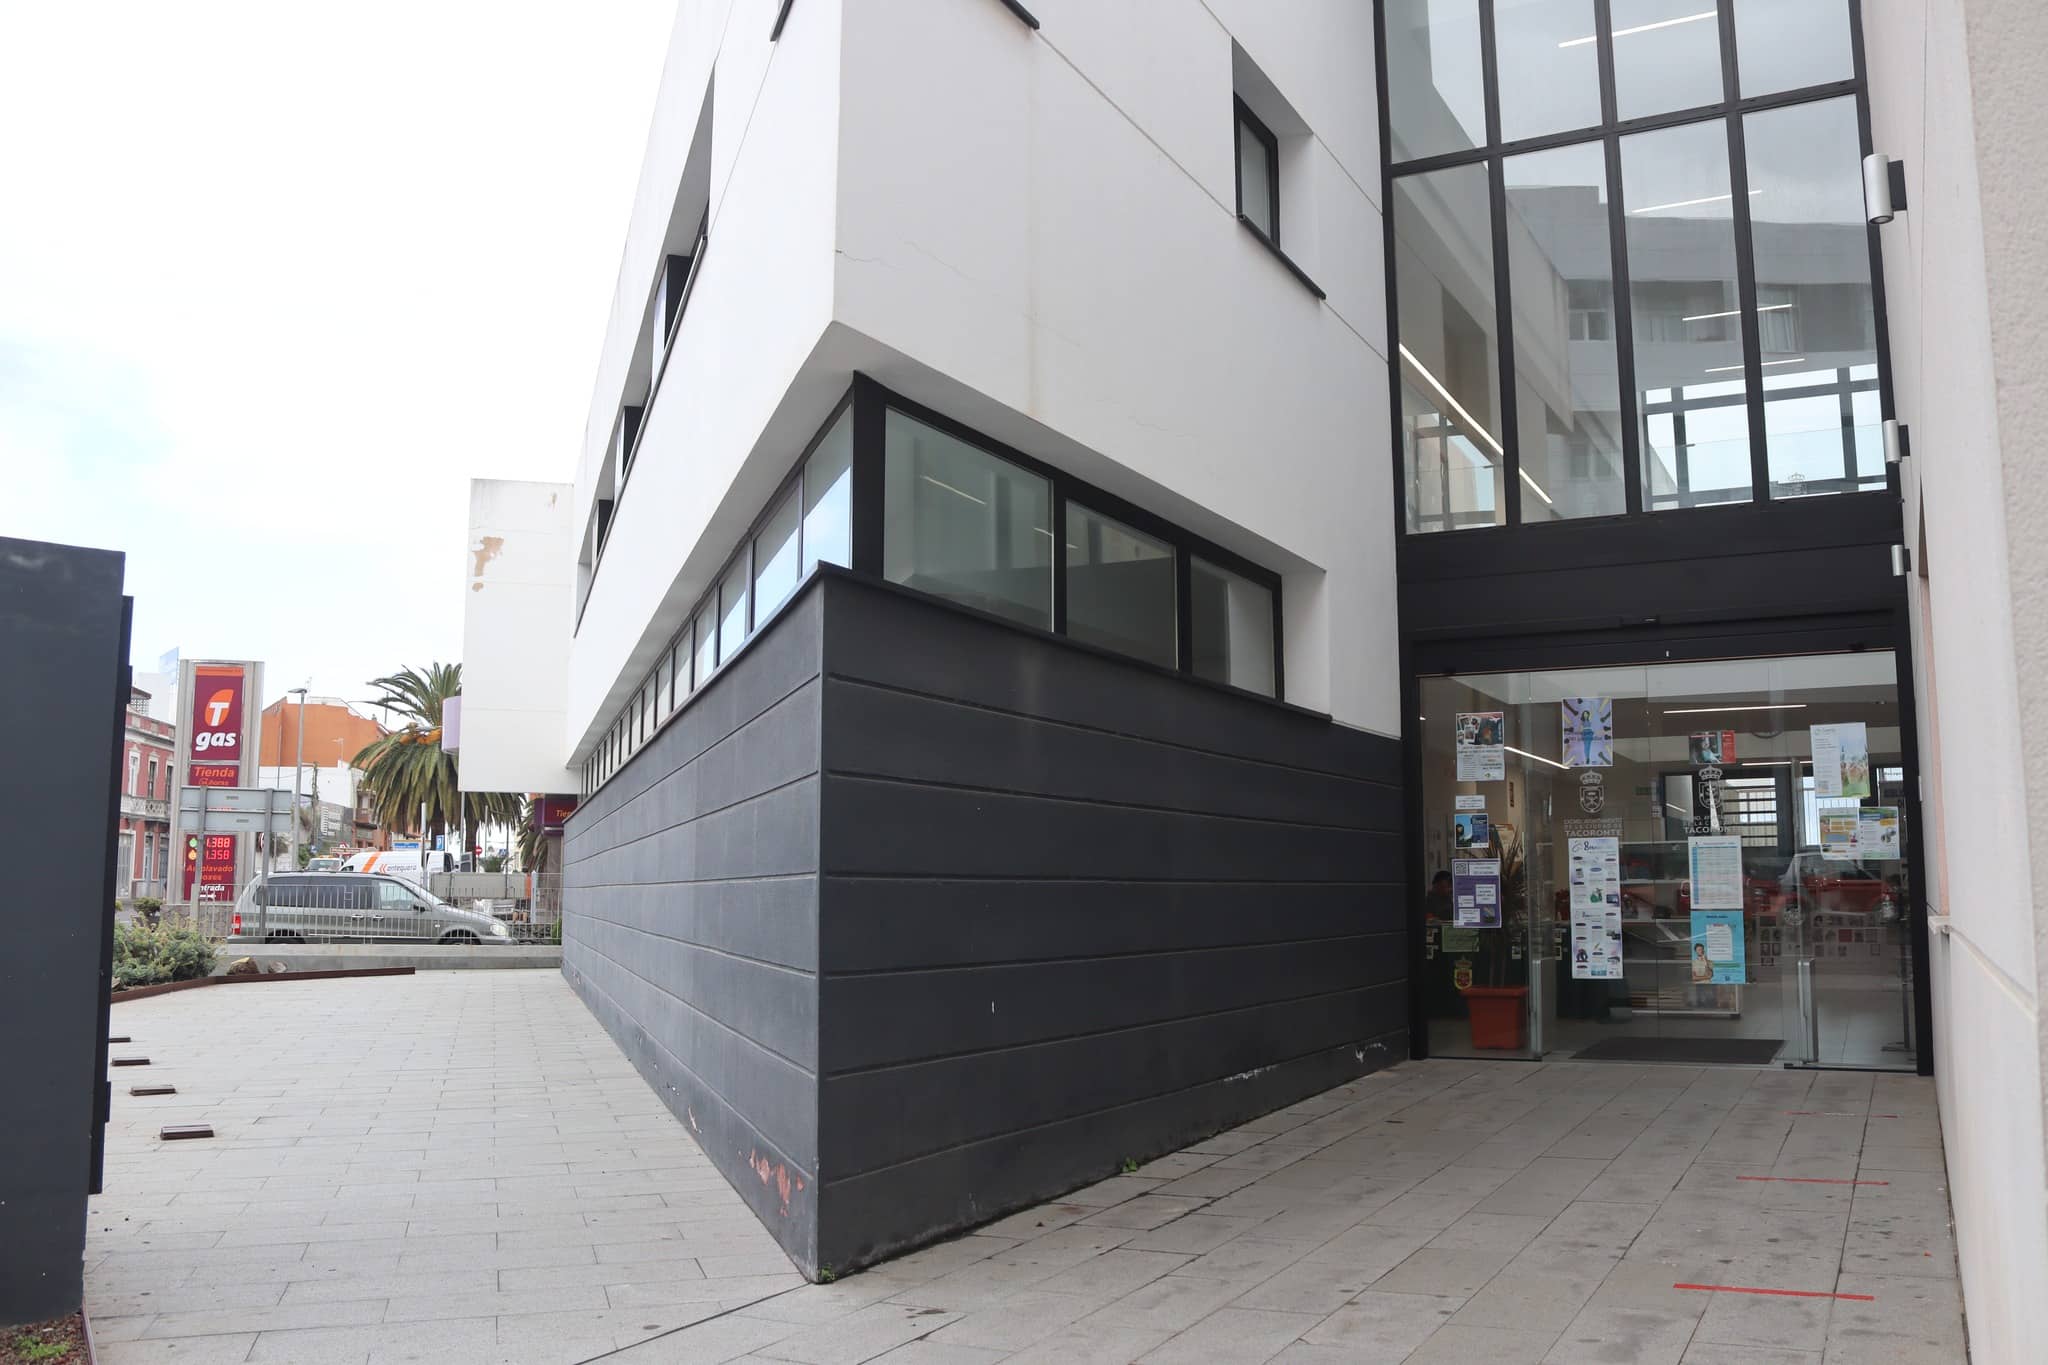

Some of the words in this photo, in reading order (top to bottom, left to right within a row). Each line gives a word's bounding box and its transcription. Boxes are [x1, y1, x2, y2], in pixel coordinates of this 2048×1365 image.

[209, 702, 230, 727] T
[195, 731, 236, 751] gas
[194, 766, 235, 778] Tienda
[1564, 829, 1622, 837] TACORONTE
[186, 864, 233, 873] Aolavado
[200, 884, 225, 892] ntrada
